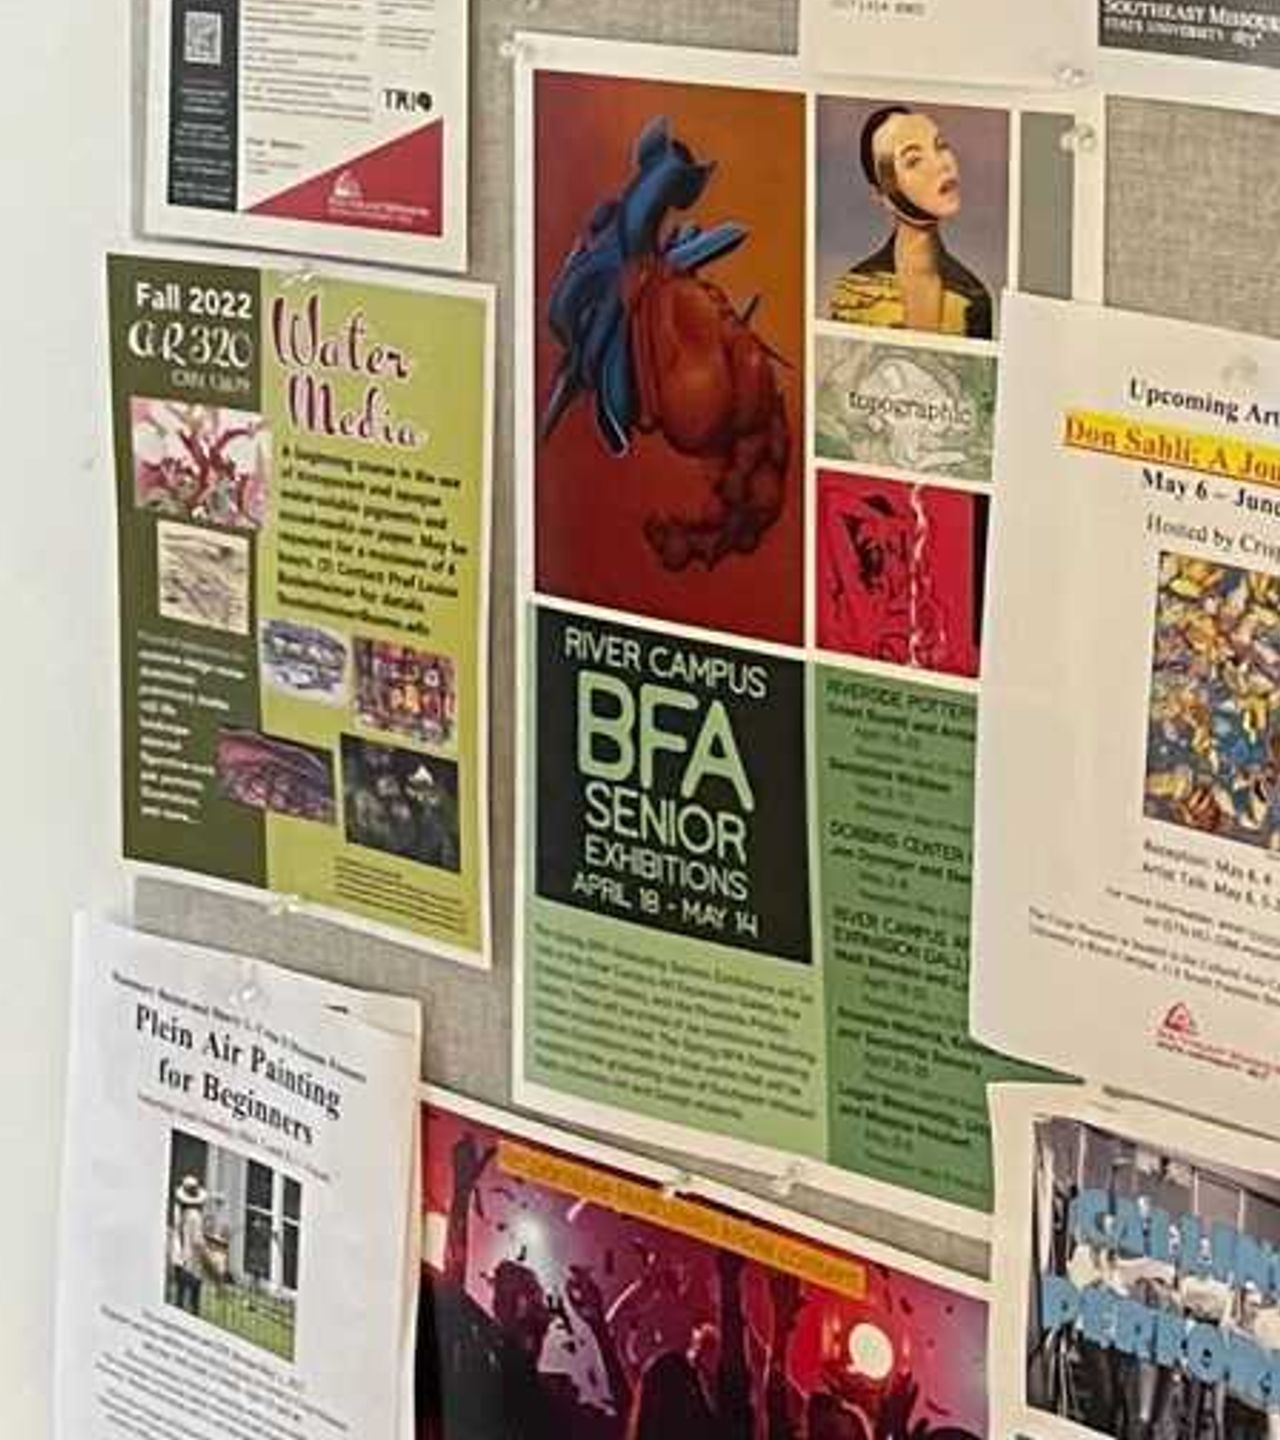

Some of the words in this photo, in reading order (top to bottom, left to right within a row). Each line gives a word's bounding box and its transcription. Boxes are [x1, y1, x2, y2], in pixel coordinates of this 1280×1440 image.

[383, 88, 433, 112] TRIO
[135, 281, 181, 312] Fall
[187, 287, 253, 320] 2022
[272, 294, 410, 379] Water
[288, 374, 420, 448] Media
[1129, 376, 1240, 424] Upcoming
[1064, 415, 1117, 449] Don
[1123, 424, 1199, 465] Sahli:
[1207, 446, 1230, 471] A
[1141, 467, 1188, 502] May
[1195, 485, 1209, 501] 6
[1145, 511, 1209, 545] Hosted
[1213, 523, 1235, 553] by
[564, 626, 642, 674] RIVER
[648, 646, 769, 699] CAMPUS
[576, 669, 755, 813] BFA
[584, 781, 748, 863] SENIOR
[584, 835, 748, 902] EXHIBITIONS
[572, 872, 633, 910] APRIL
[639, 887, 662, 915] 18
[681, 898, 727, 930] MAY
[735, 913, 759, 938] 14
[135, 1001, 196, 1051] Plein
[202, 1028, 243, 1064] Air
[250, 1044, 343, 1120] Painting
[156, 1055, 194, 1093] for
[202, 1070, 315, 1146] Beginners
